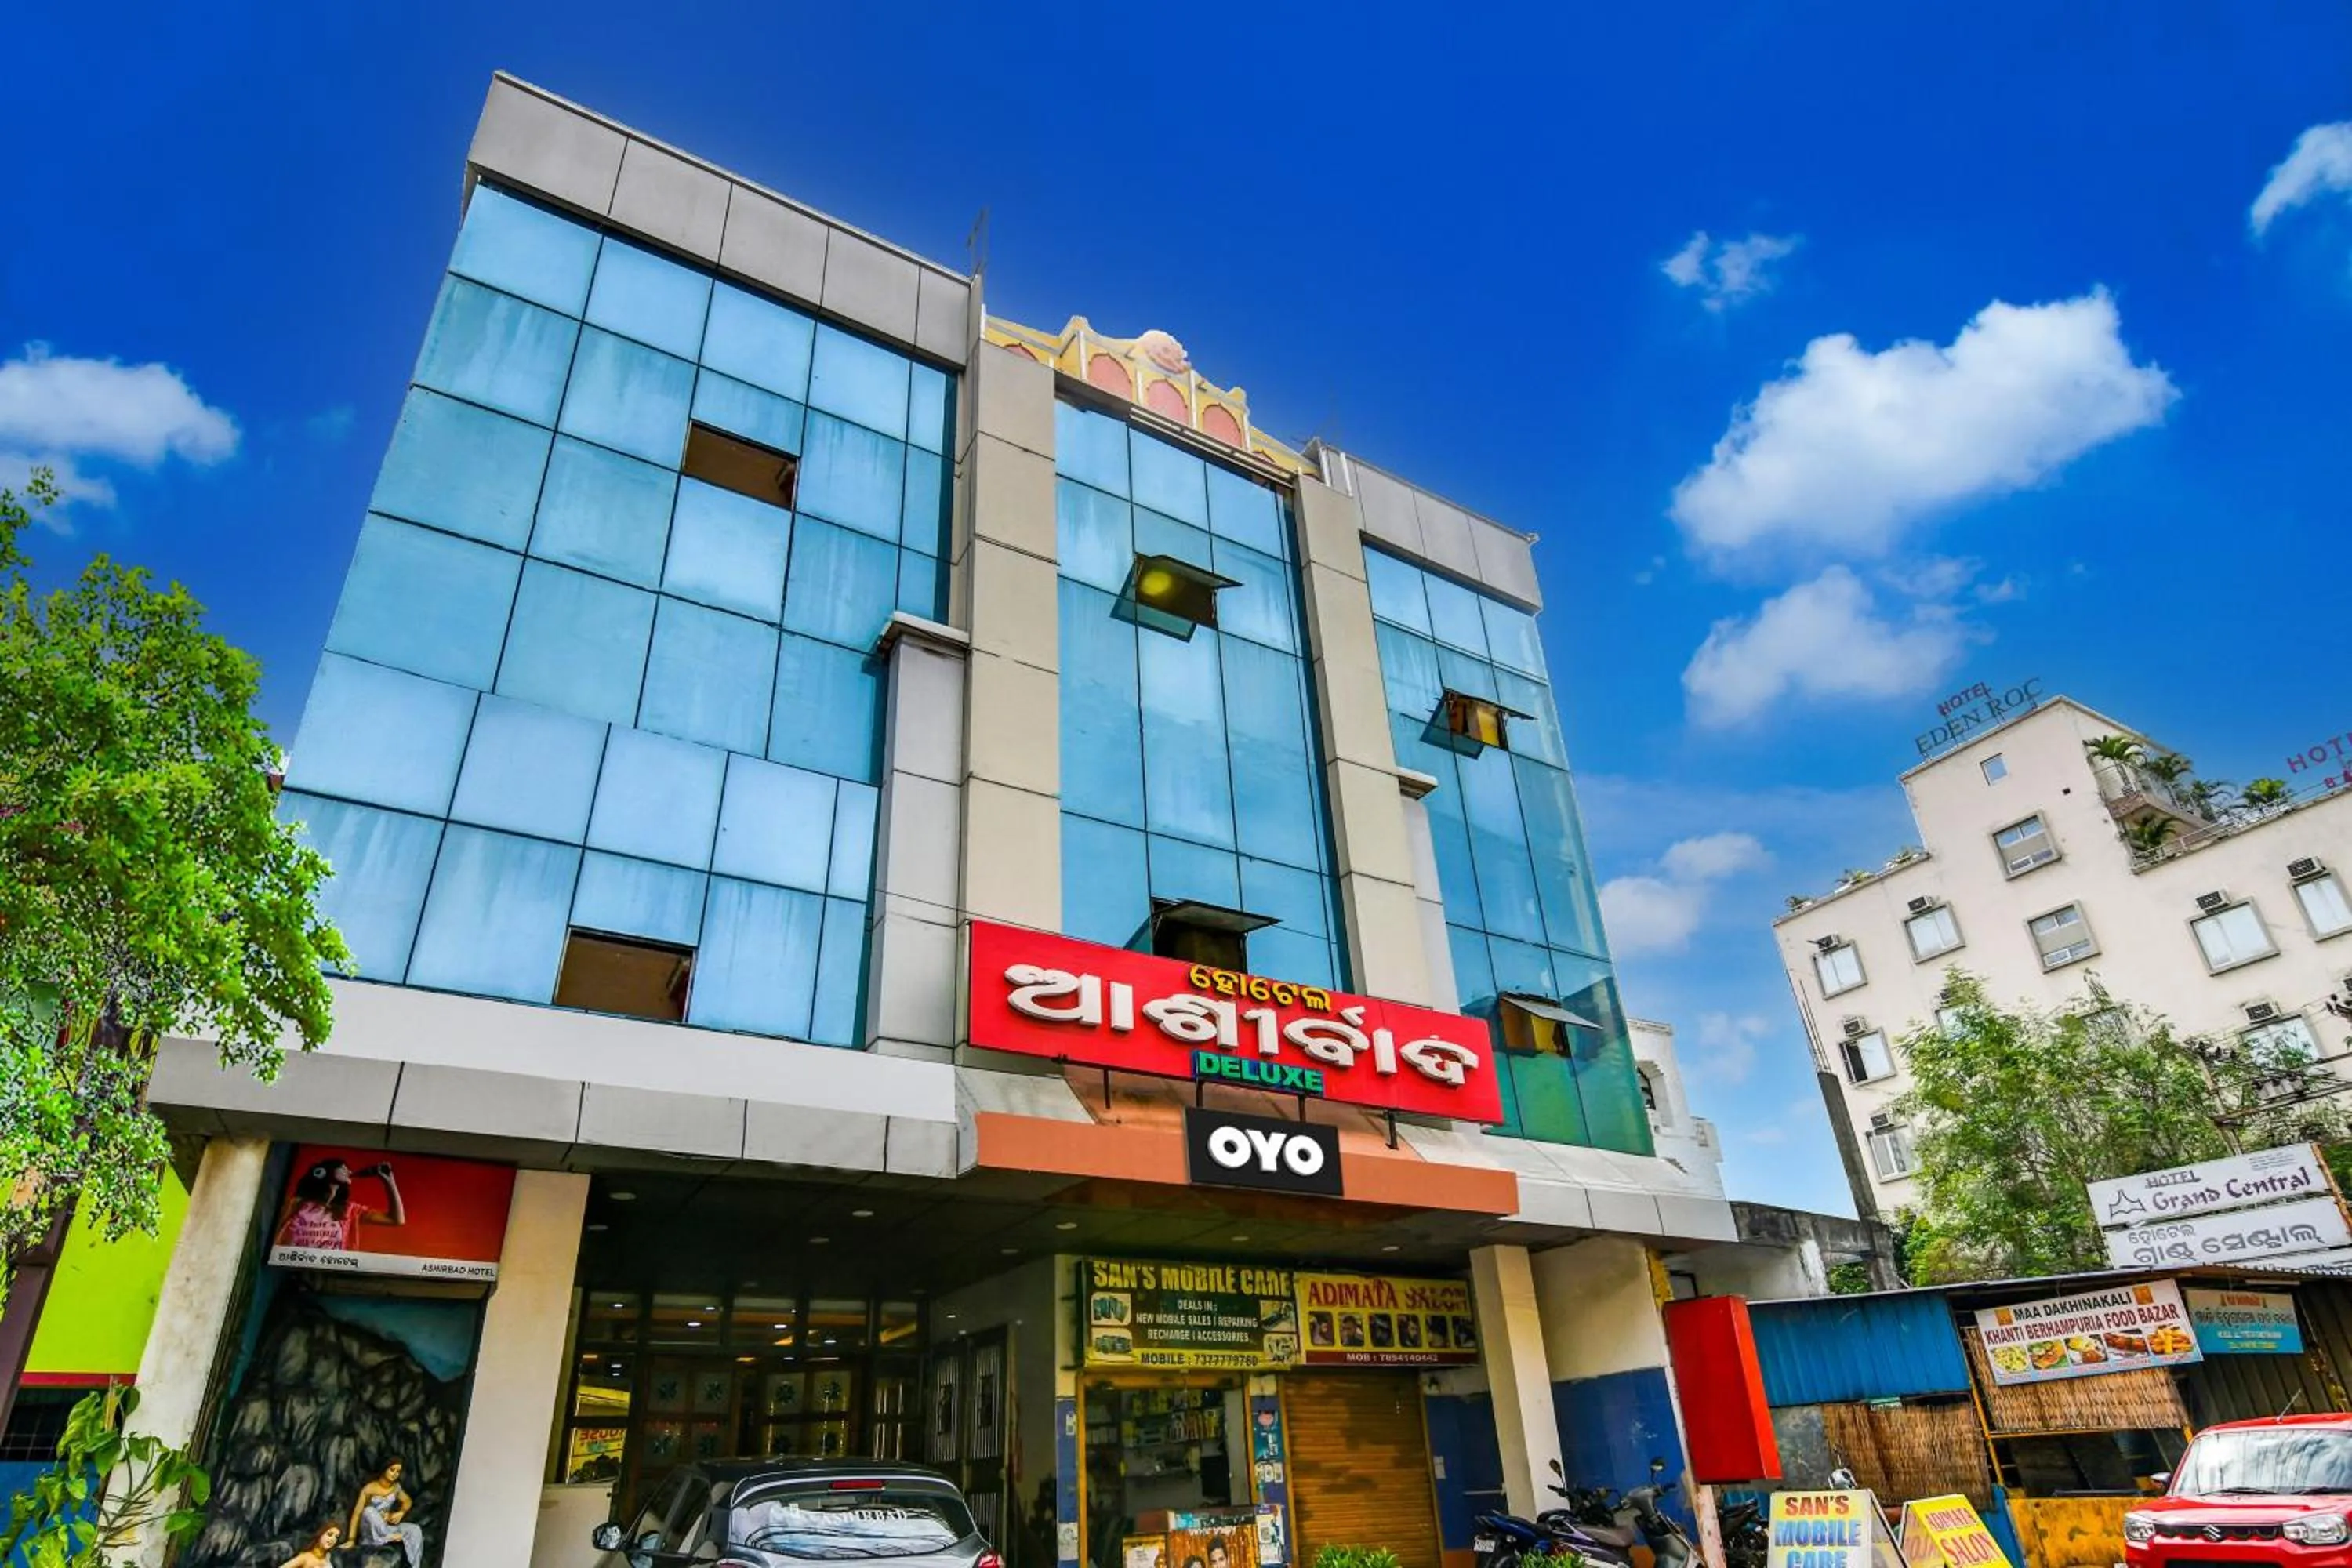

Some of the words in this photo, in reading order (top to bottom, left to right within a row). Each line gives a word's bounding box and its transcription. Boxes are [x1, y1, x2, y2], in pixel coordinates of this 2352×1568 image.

[1937, 682, 1991, 715] HOTEL
[1915, 708, 1980, 753] EDEN
[1985, 678, 2043, 717] ROC
[1189, 965, 1330, 1012] ହୋଟେଲ
[1197, 1051, 1323, 1092] DELUXE
[1208, 1127, 1324, 1178] OYO
[2145, 1169, 2201, 1189] HOTEL
[2153, 1187, 2221, 1211] Grand
[2226, 1167, 2310, 1198] Central
[421, 1264, 466, 1274] ASHIRBAD
[467, 1266, 495, 1276] HOTEL
[1094, 1261, 1156, 1289] SAN'S
[1161, 1265, 1236, 1294] MOBILE
[1240, 1269, 1290, 1296] CARE
[1178, 1299, 1202, 1310] DEALS
[1308, 1279, 1399, 1310] ADIMATA
[2013, 1308, 2041, 1321] MAA
[2044, 1292, 2132, 1316] DAKHINAKALI
[1137, 1312, 1154, 1324] NEW
[1156, 1313, 1186, 1325] MOBILE
[1188, 1314, 1212, 1326] SALES
[1218, 1316, 1258, 1328] REPAIRING
[1984, 1327, 2025, 1345] KHANTI
[2025, 1314, 2103, 1339] BERHAMPURIA
[2105, 1310, 2136, 1328] FOOD
[2139, 1303, 2180, 1323] BAZAR
[1147, 1329, 1190, 1340] RECHARGE
[1197, 1331, 1249, 1343] ACCESSORIES
[1141, 1353, 1185, 1365] MOBILE
[1347, 1352, 1370, 1362] MOB
[1784, 1495, 1849, 1516] SAN'S
[1925, 1508, 1977, 1530] ADIMATA
[1774, 1519, 1861, 1547] MOBILE
[1786, 1548, 1848, 1568] CARE
[1940, 1531, 2001, 1566] SALON
